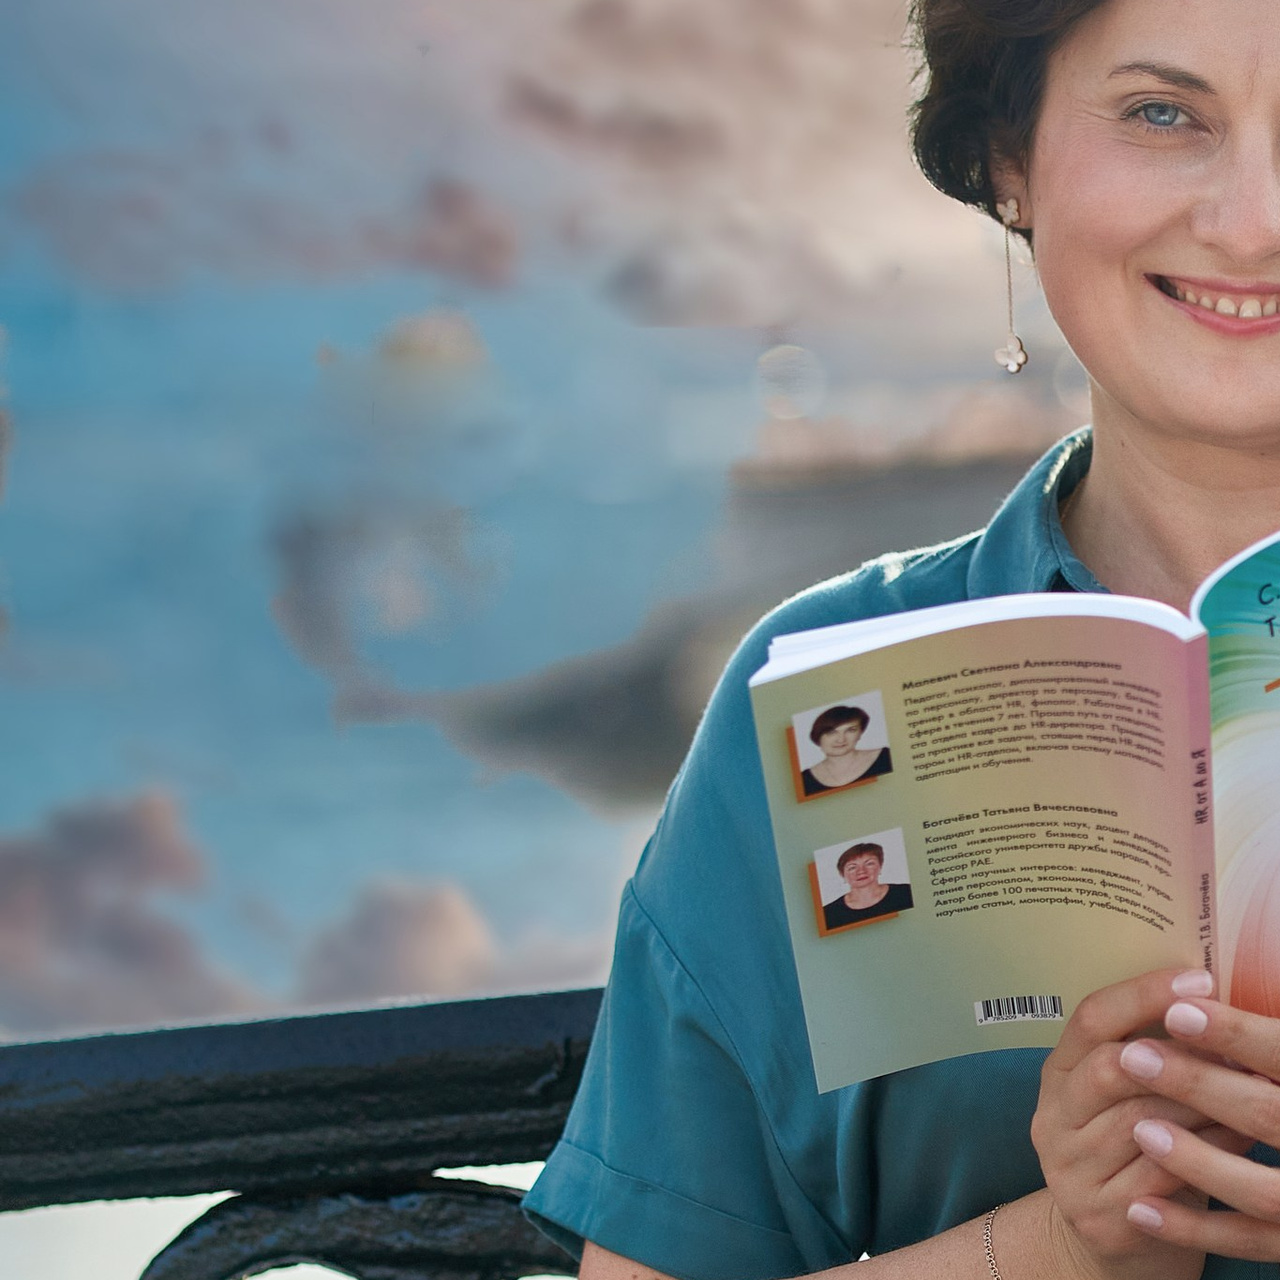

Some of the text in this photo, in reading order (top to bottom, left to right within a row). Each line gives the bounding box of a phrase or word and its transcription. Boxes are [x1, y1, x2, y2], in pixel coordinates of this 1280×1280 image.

[922, 804, 1118, 829] Богачёва Татьяна Вячеславовна
[930, 862, 968, 876] фессор
[932, 874, 967, 886] Сфера
[971, 867, 1016, 879] научных
[1020, 864, 1077, 872] интересов:
[1081, 867, 1143, 886] менеджмент,
[933, 875, 1144, 898] ление персоналом, экономика, финансы.
[935, 896, 965, 907] Автор
[968, 890, 998, 900] более
[1002, 886, 1022, 895] 100
[1075, 887, 1111, 899] трудов,
[1115, 895, 1141, 908] среди
[936, 905, 979, 917] научные
[982, 899, 1016, 909] статьи,
[1019, 896, 1086, 906] монографии,
[1089, 900, 1128, 914] учебные
